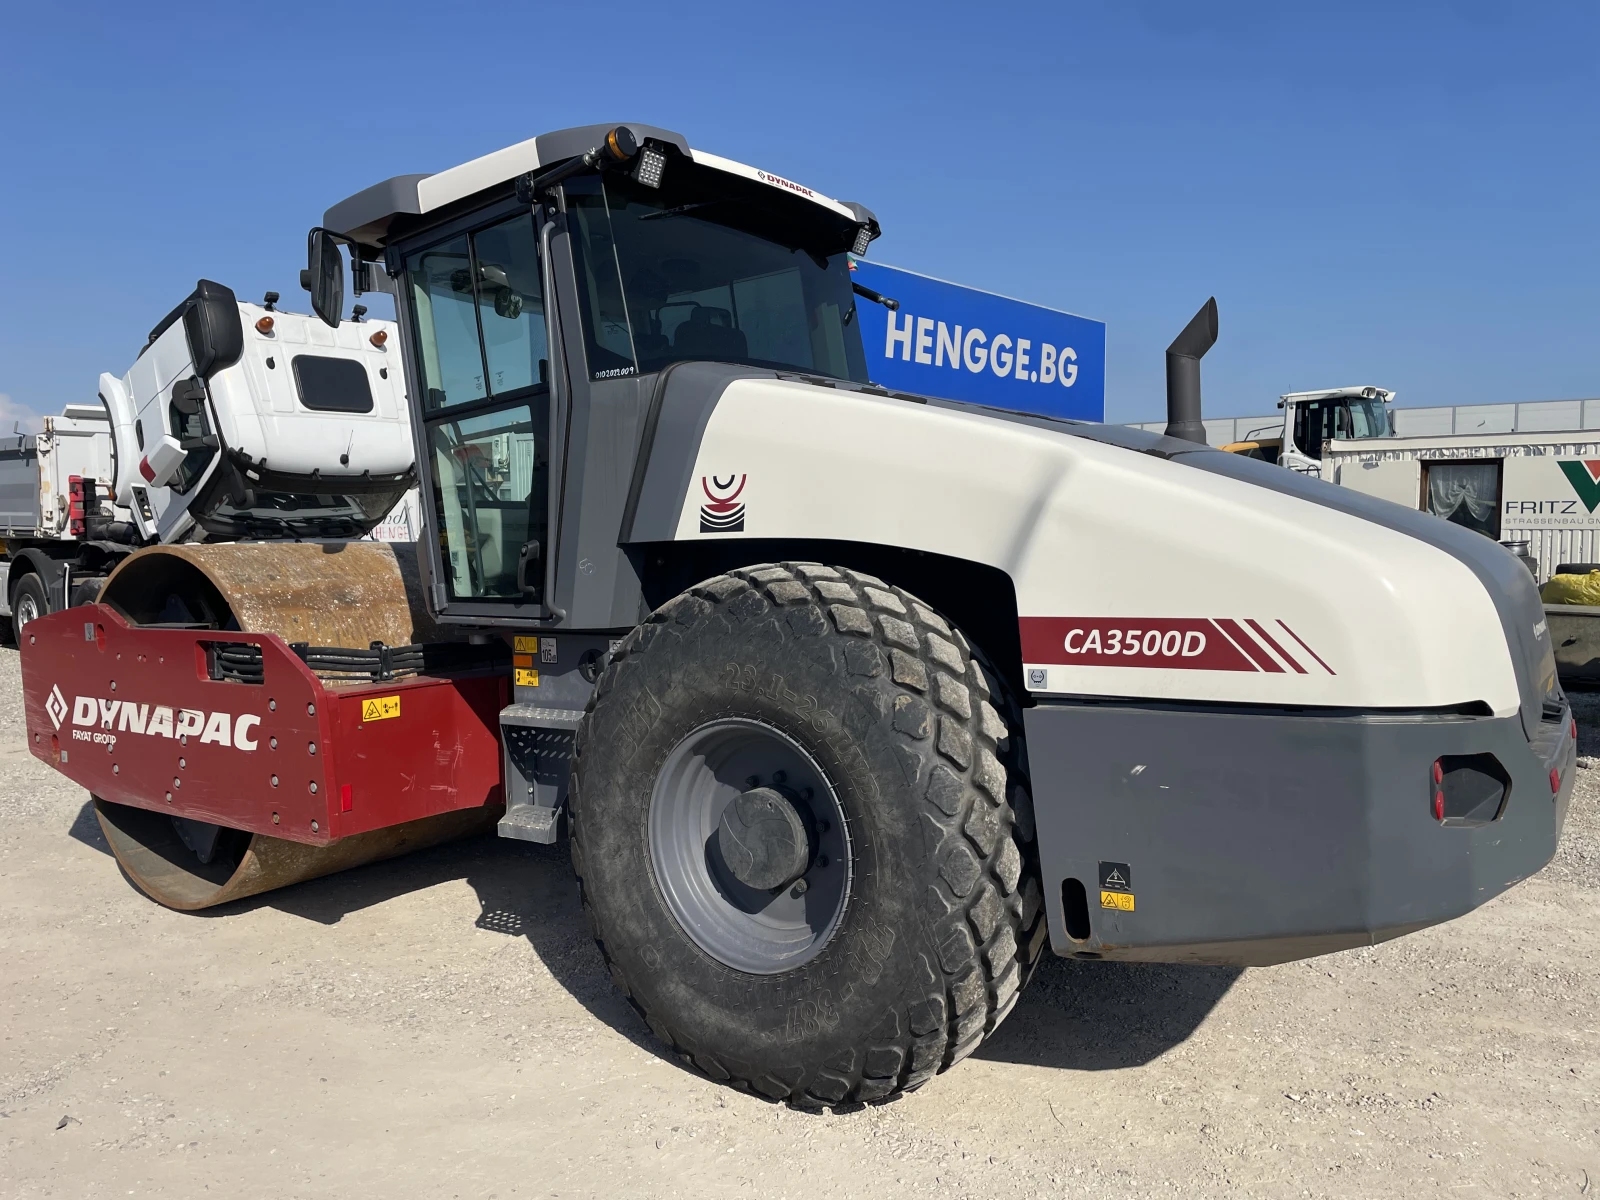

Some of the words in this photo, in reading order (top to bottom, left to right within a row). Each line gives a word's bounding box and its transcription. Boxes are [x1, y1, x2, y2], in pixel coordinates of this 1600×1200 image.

[766, 174, 814, 198] DYNAPAC
[885, 310, 1079, 388] HENGGE.BG
[1506, 500, 1577, 514] FRITZ
[1064, 629, 1206, 656] CA3500D
[72, 695, 261, 750] DYNAPAC
[72, 730, 92, 741] FAYAT
[93, 733, 117, 745] GROUP
